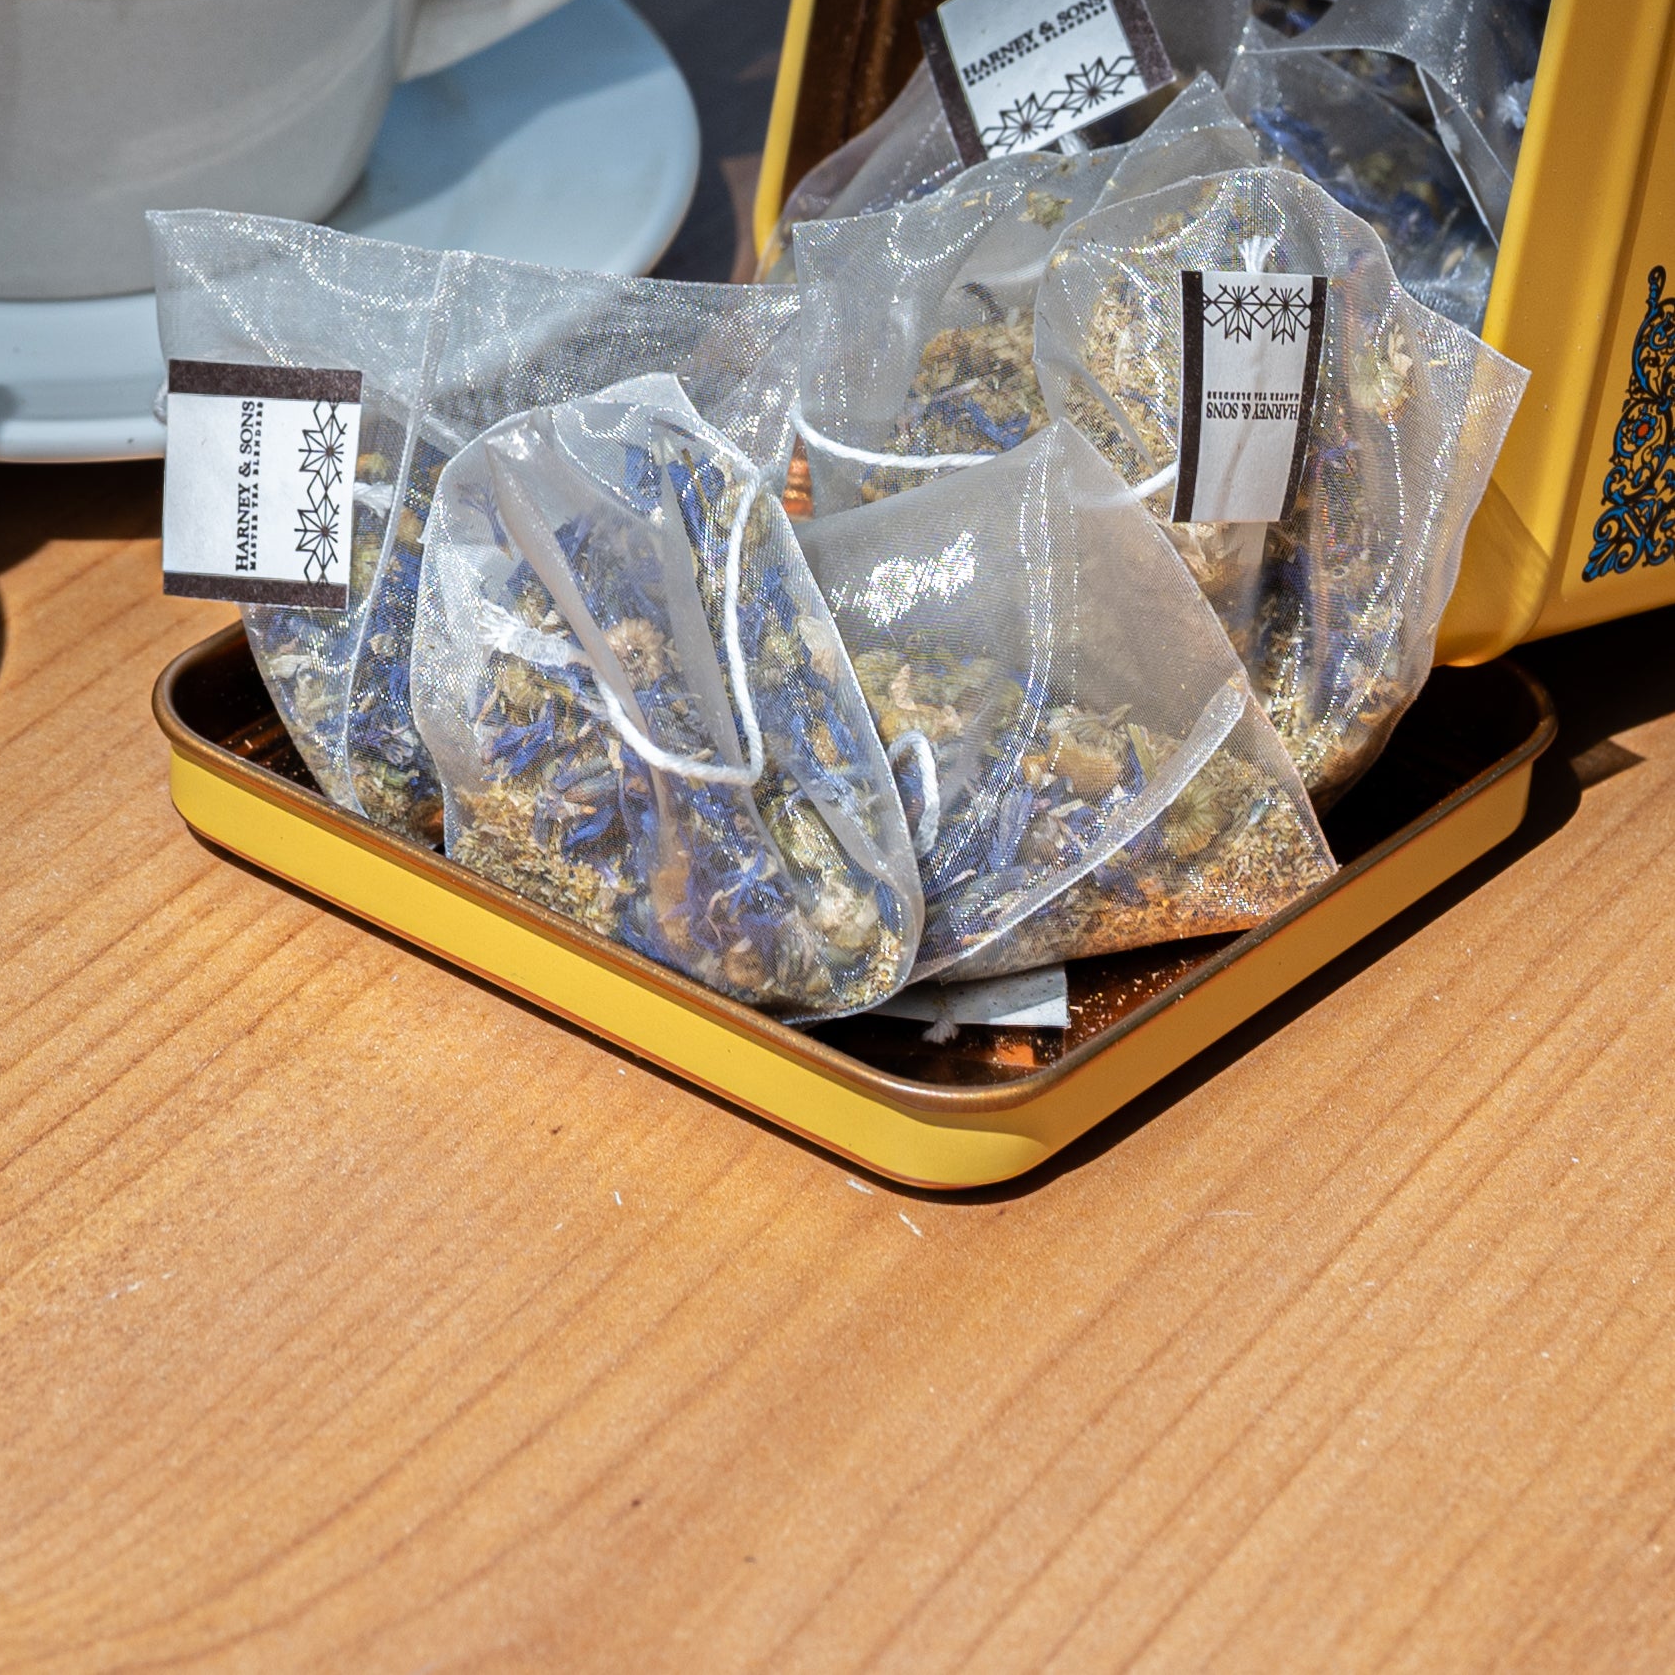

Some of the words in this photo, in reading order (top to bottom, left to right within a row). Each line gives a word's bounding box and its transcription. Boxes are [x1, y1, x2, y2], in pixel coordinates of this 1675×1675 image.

[961, 29, 1035, 81] HARNEY
[1039, 21, 1055, 36] &
[1206, 401, 1239, 419] SONS
[1241, 404, 1251, 419] &
[1252, 403, 1299, 421] HARNEY
[239, 400, 256, 455] SONS
[238, 462, 252, 478] &
[235, 482, 251, 572] HARNEY
